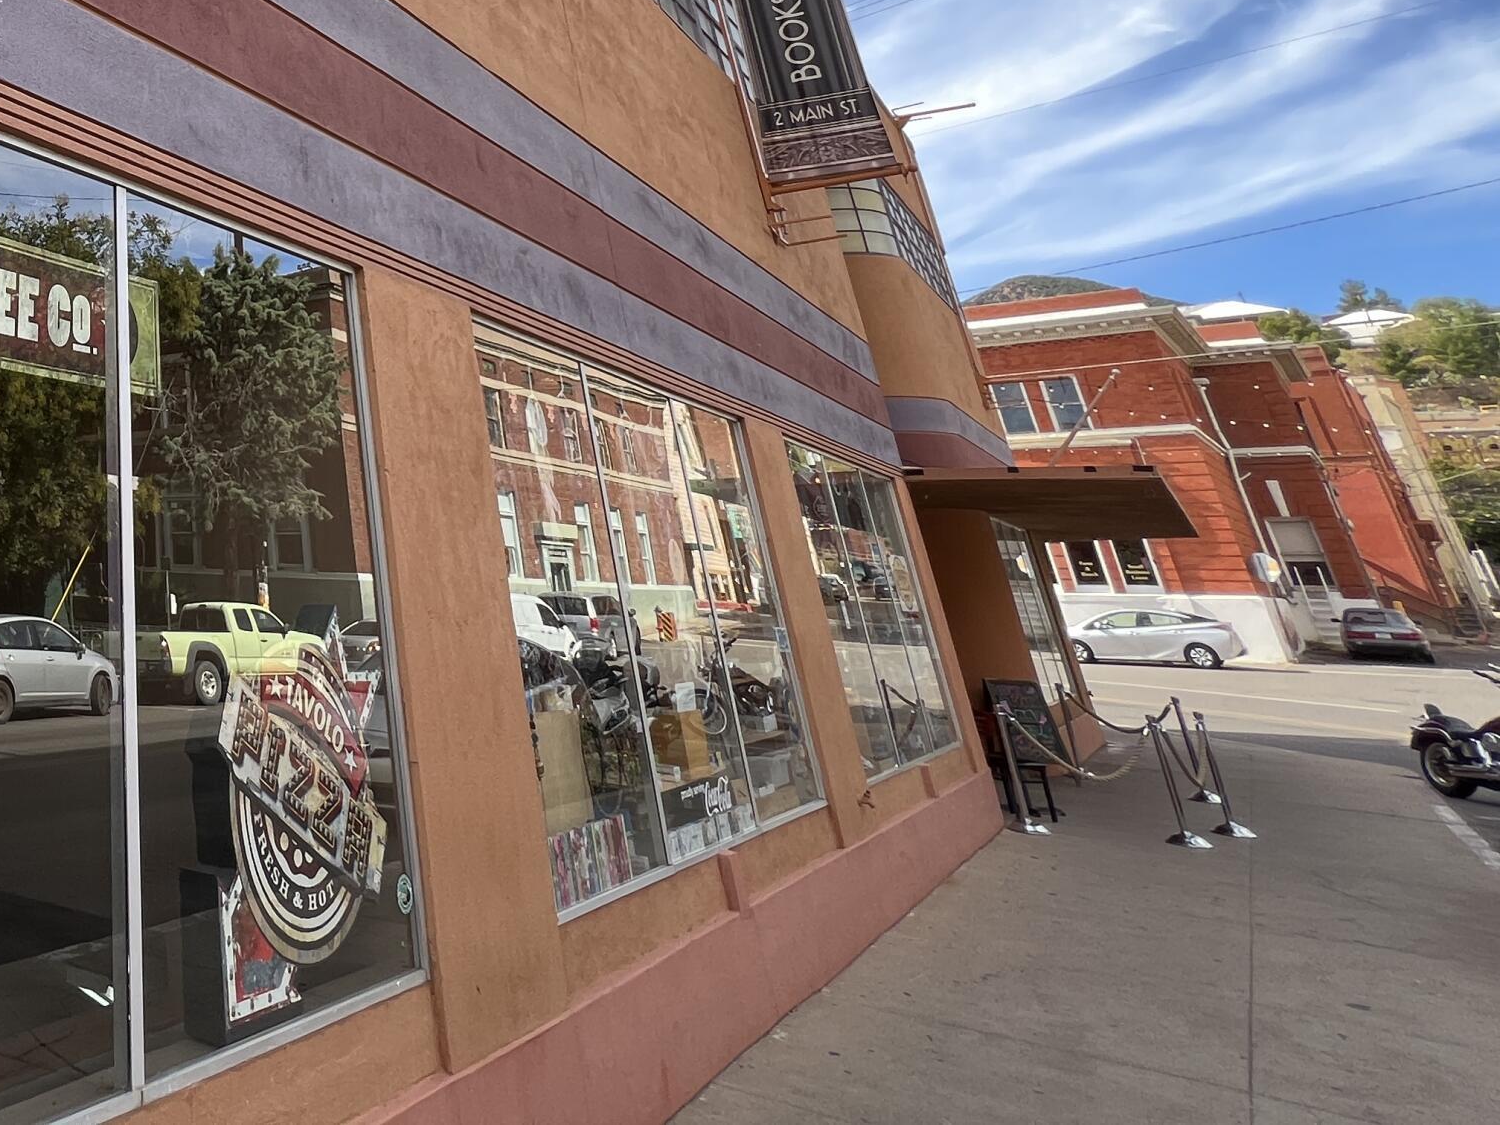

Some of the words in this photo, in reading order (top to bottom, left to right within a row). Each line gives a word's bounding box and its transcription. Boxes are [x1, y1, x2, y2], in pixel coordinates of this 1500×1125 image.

[773, 111, 785, 126] 2
[788, 101, 835, 125] MAIN
[840, 98, 861, 115] ST.
[285, 676, 345, 754] TAVOLO
[232, 691, 373, 877] PIZZA
[253, 811, 290, 900] FRESH
[292, 891, 304, 909] &
[307, 880, 335, 911] HOT
